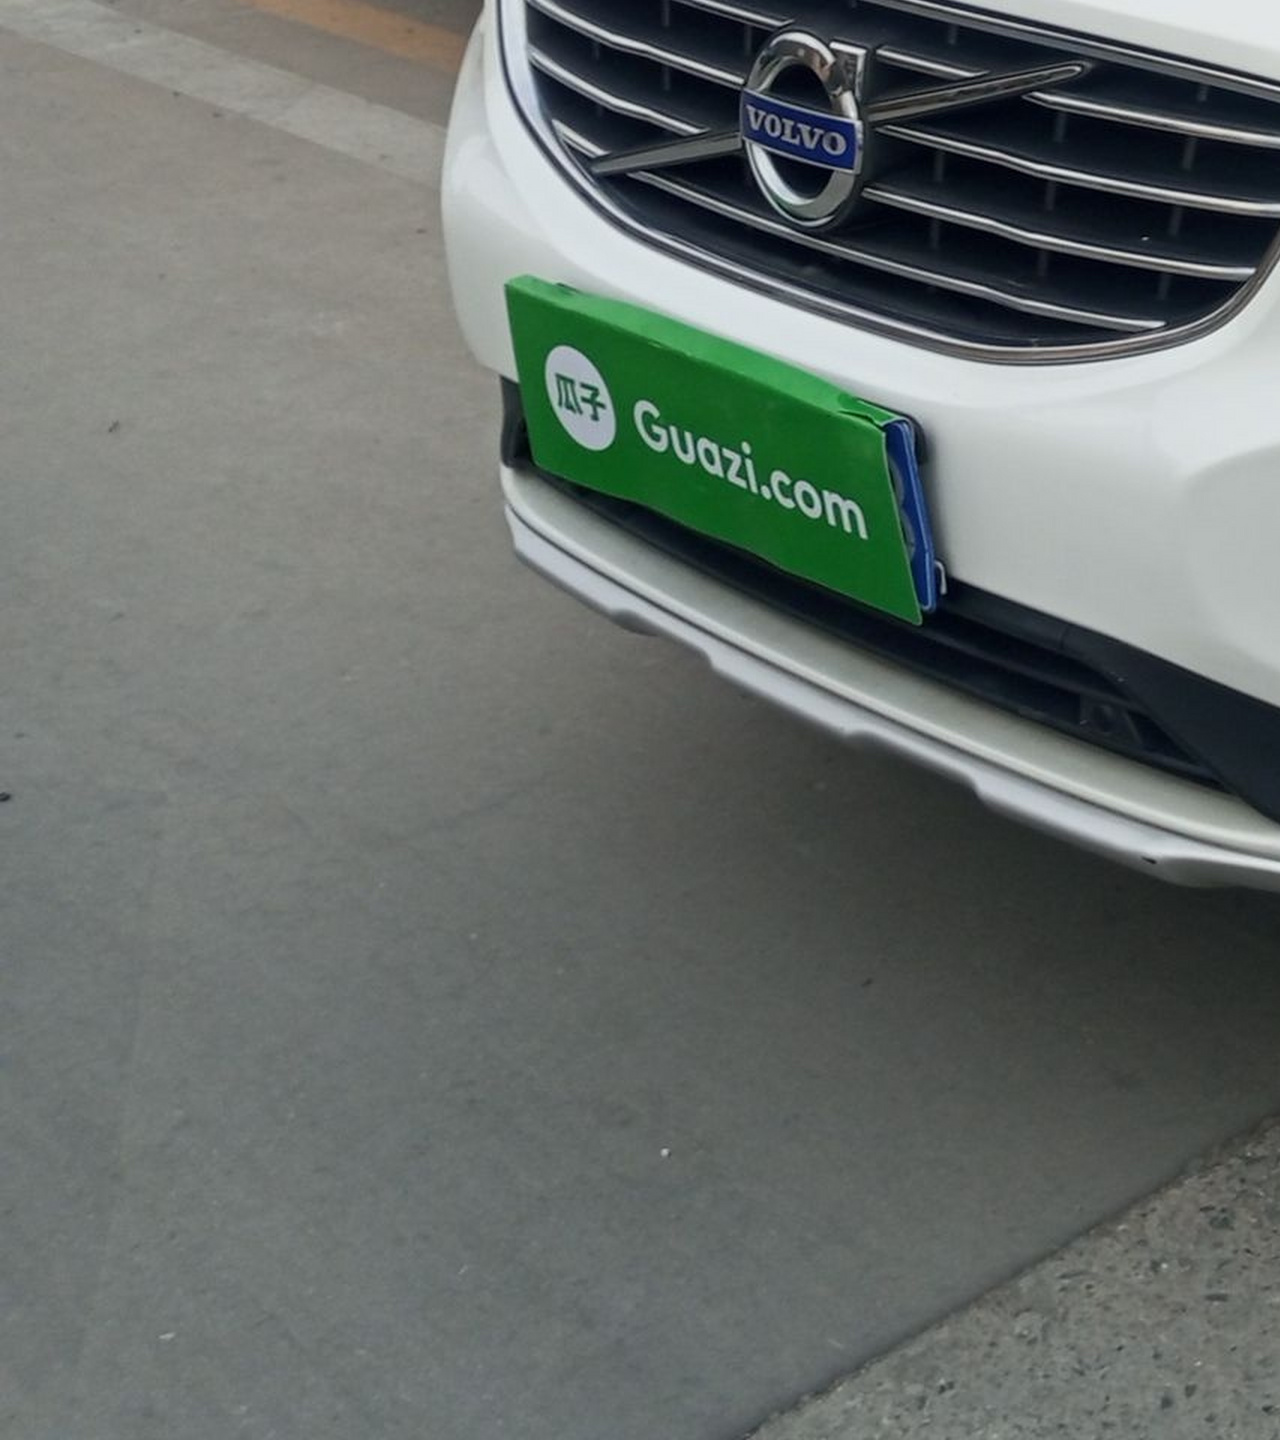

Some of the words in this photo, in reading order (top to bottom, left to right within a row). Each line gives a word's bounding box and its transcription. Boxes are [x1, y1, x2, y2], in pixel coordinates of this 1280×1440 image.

[745, 104, 847, 156] VOLVO
[554, 372, 607, 422] 瓜子
[633, 399, 869, 540] Guazi.com
